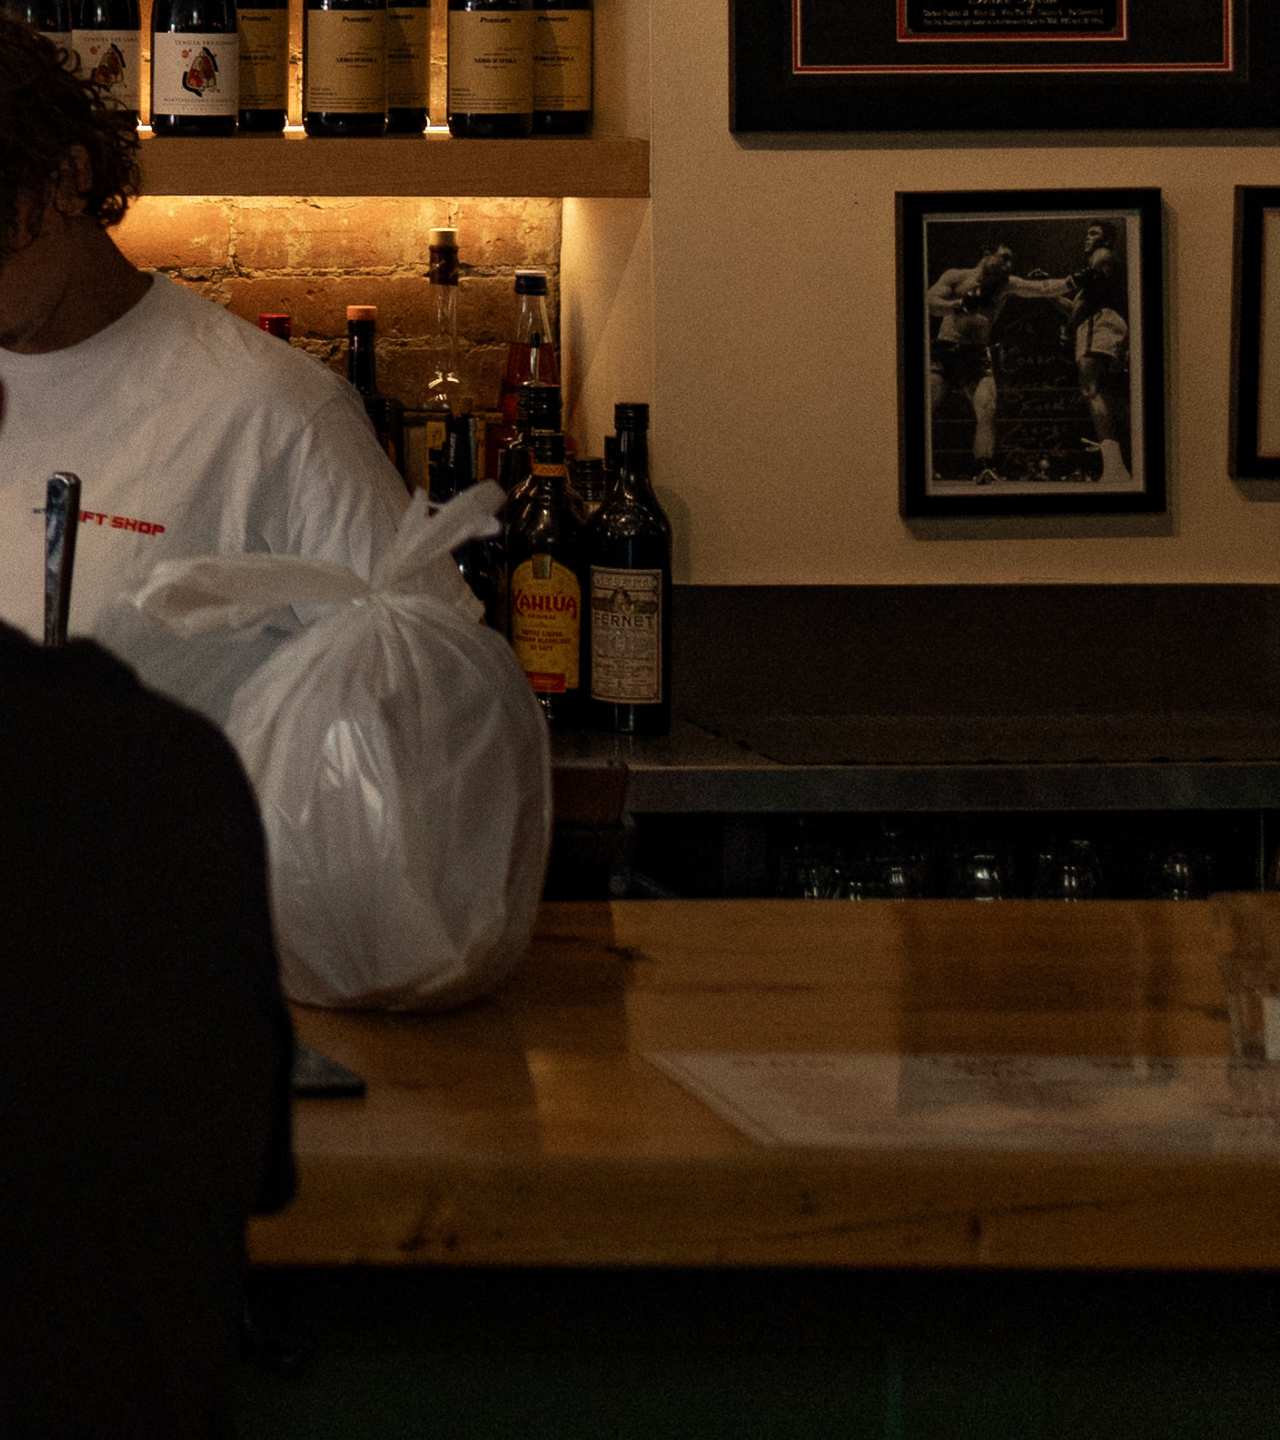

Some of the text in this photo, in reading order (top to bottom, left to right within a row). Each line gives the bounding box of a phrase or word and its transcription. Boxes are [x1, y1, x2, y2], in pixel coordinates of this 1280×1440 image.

[78, 510, 166, 536] IFT SHOP
[594, 615, 653, 627] FERNET
